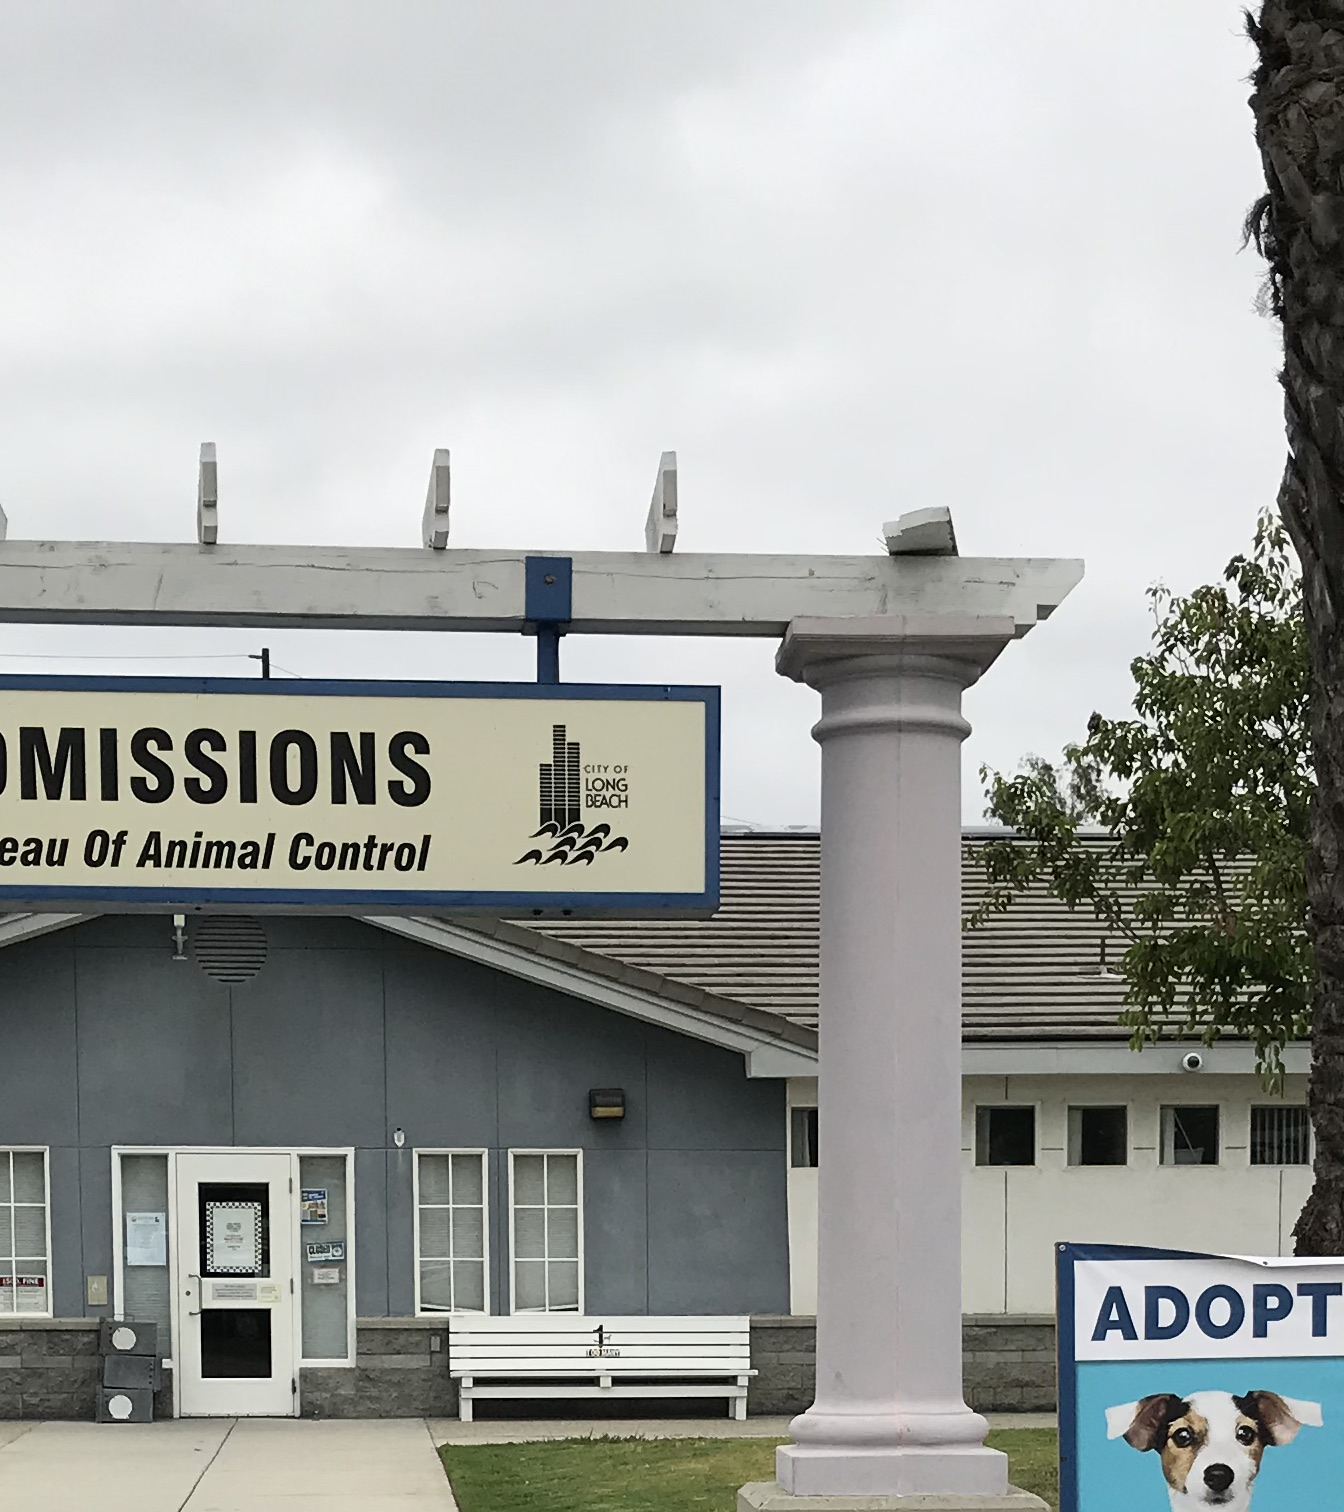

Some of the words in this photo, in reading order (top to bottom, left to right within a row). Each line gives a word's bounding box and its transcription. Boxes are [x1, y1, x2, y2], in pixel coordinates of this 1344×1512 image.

[583, 764, 610, 774] CITY
[613, 764, 630, 774] OF
[585, 777, 629, 792] LONG
[585, 793, 629, 809] BEACH
[83, 829, 129, 868] Of
[135, 830, 276, 870] Animal
[288, 832, 432, 872] Control
[1090, 1282, 1343, 1342] ADOPT
